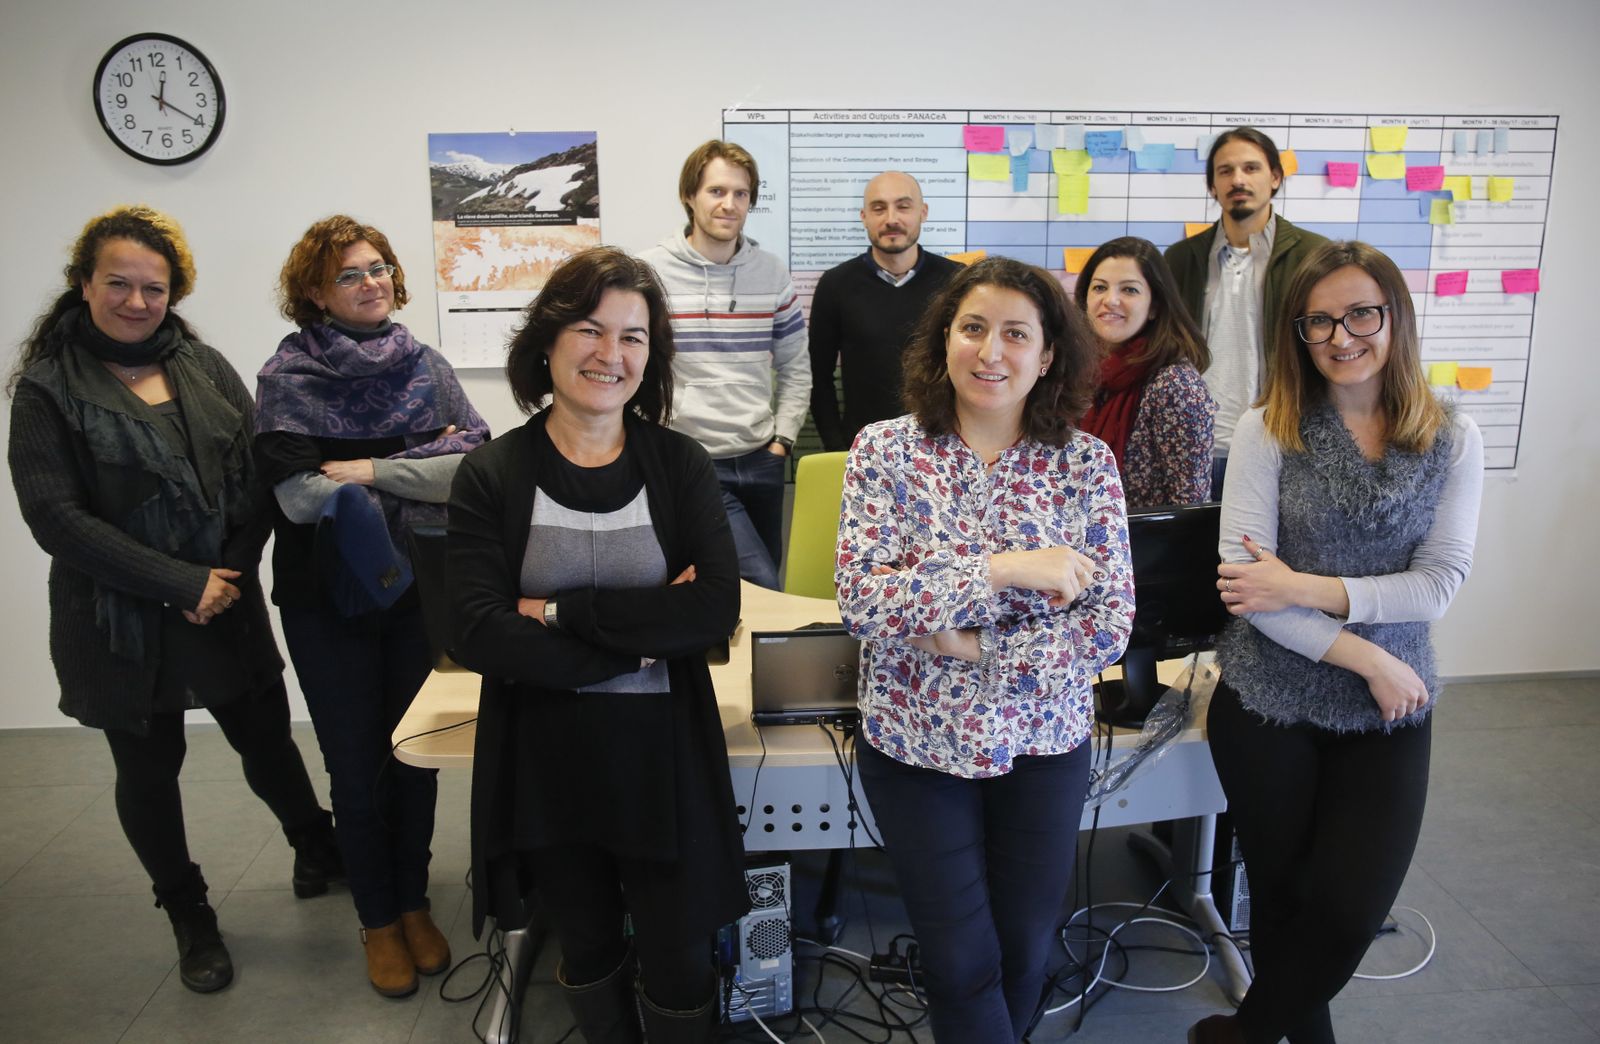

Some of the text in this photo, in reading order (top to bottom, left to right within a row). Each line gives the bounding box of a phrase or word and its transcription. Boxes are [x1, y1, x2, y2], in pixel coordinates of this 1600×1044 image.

[129, 57, 142, 72] 11
[148, 52, 166, 67] 12
[176, 56, 182, 71] 1
[115, 72, 133, 88] 10
[187, 72, 199, 87] 2
[116, 93, 128, 109] 9
[195, 92, 207, 108] 3
[124, 114, 136, 130] 8
[193, 113, 206, 128] 4
[747, 112, 765, 120] WPs
[813, 112, 850, 120] Activities
[852, 112, 867, 120] and
[869, 112, 900, 122] Outputs
[907, 112, 947, 120] PANACeA
[142, 130, 153, 145] 7
[161, 133, 173, 148] 6
[182, 129, 194, 144] 5
